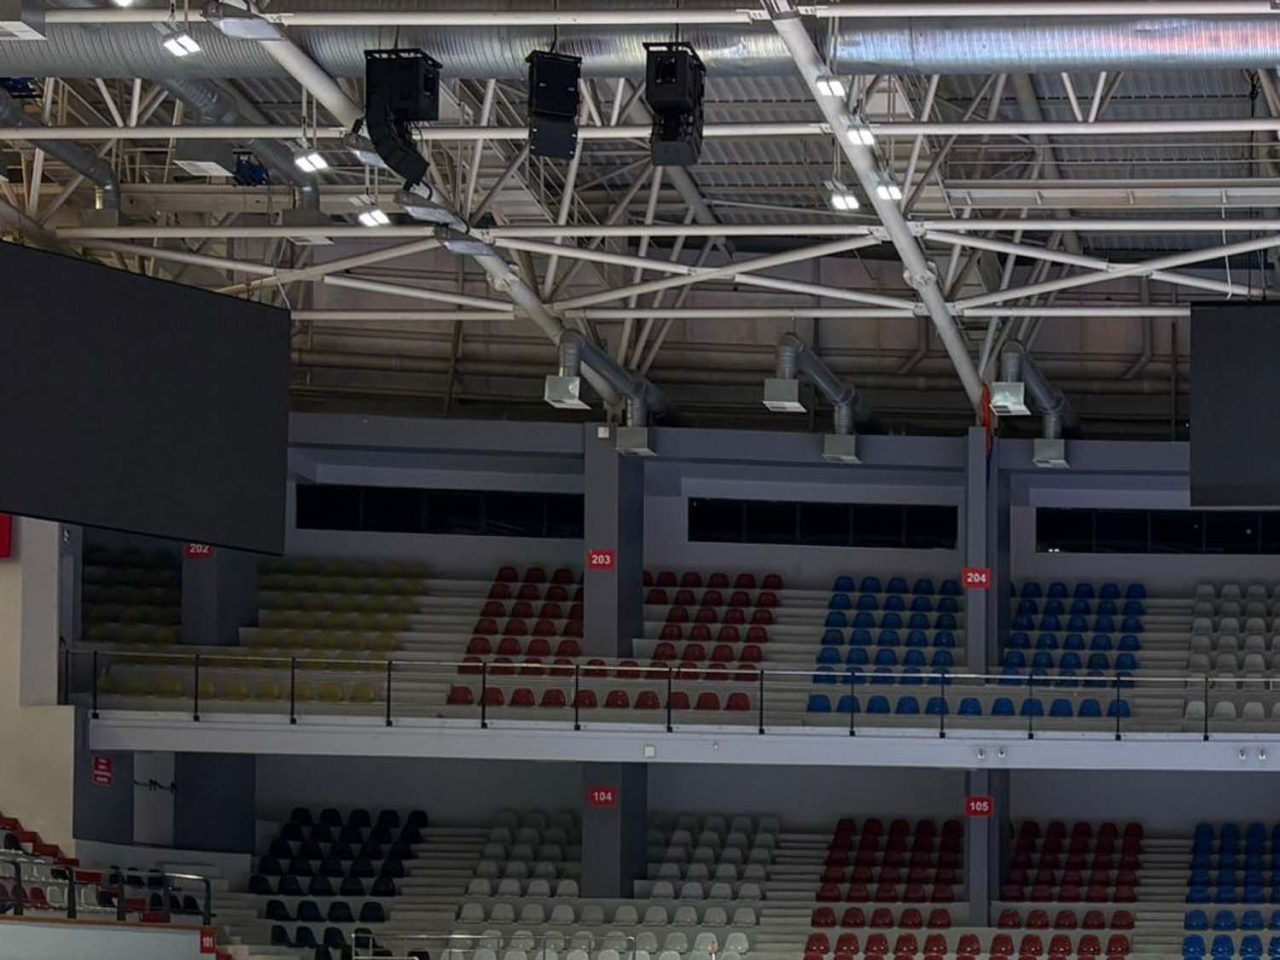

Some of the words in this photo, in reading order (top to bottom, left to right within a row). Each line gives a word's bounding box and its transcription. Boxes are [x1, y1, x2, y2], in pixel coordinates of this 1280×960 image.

[592, 554, 611, 565] 203
[966, 572, 987, 583] 204
[592, 791, 612, 801] 104
[970, 801, 989, 812] 105
